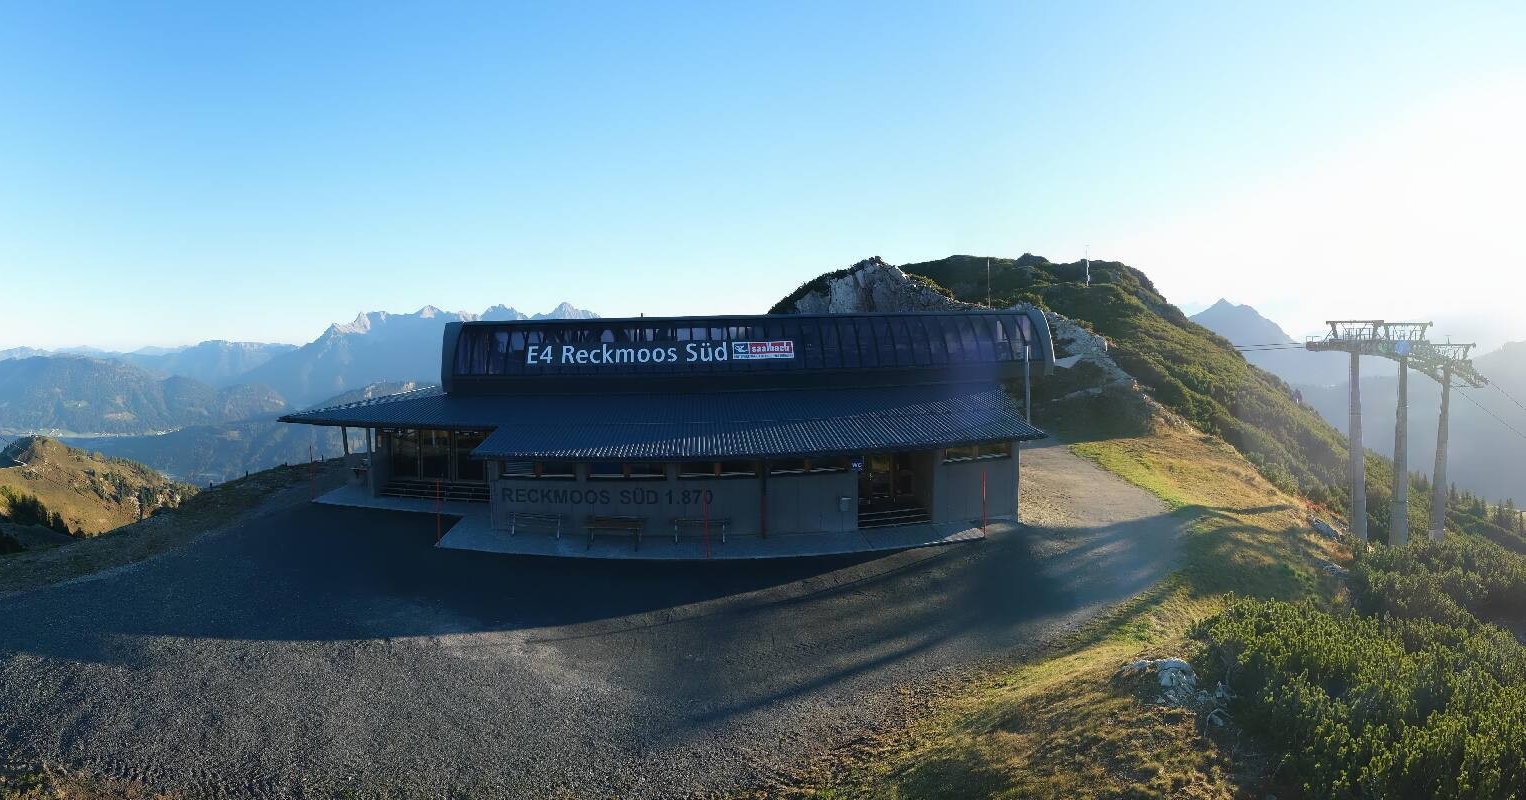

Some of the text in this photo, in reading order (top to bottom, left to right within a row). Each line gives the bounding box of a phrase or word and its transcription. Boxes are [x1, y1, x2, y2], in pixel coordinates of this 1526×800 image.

[527, 341, 728, 364] E4 Reckmoos Süd
[751, 342, 790, 353] saalbach
[501, 487, 714, 505] RECKMOOS SÜD 1.870
